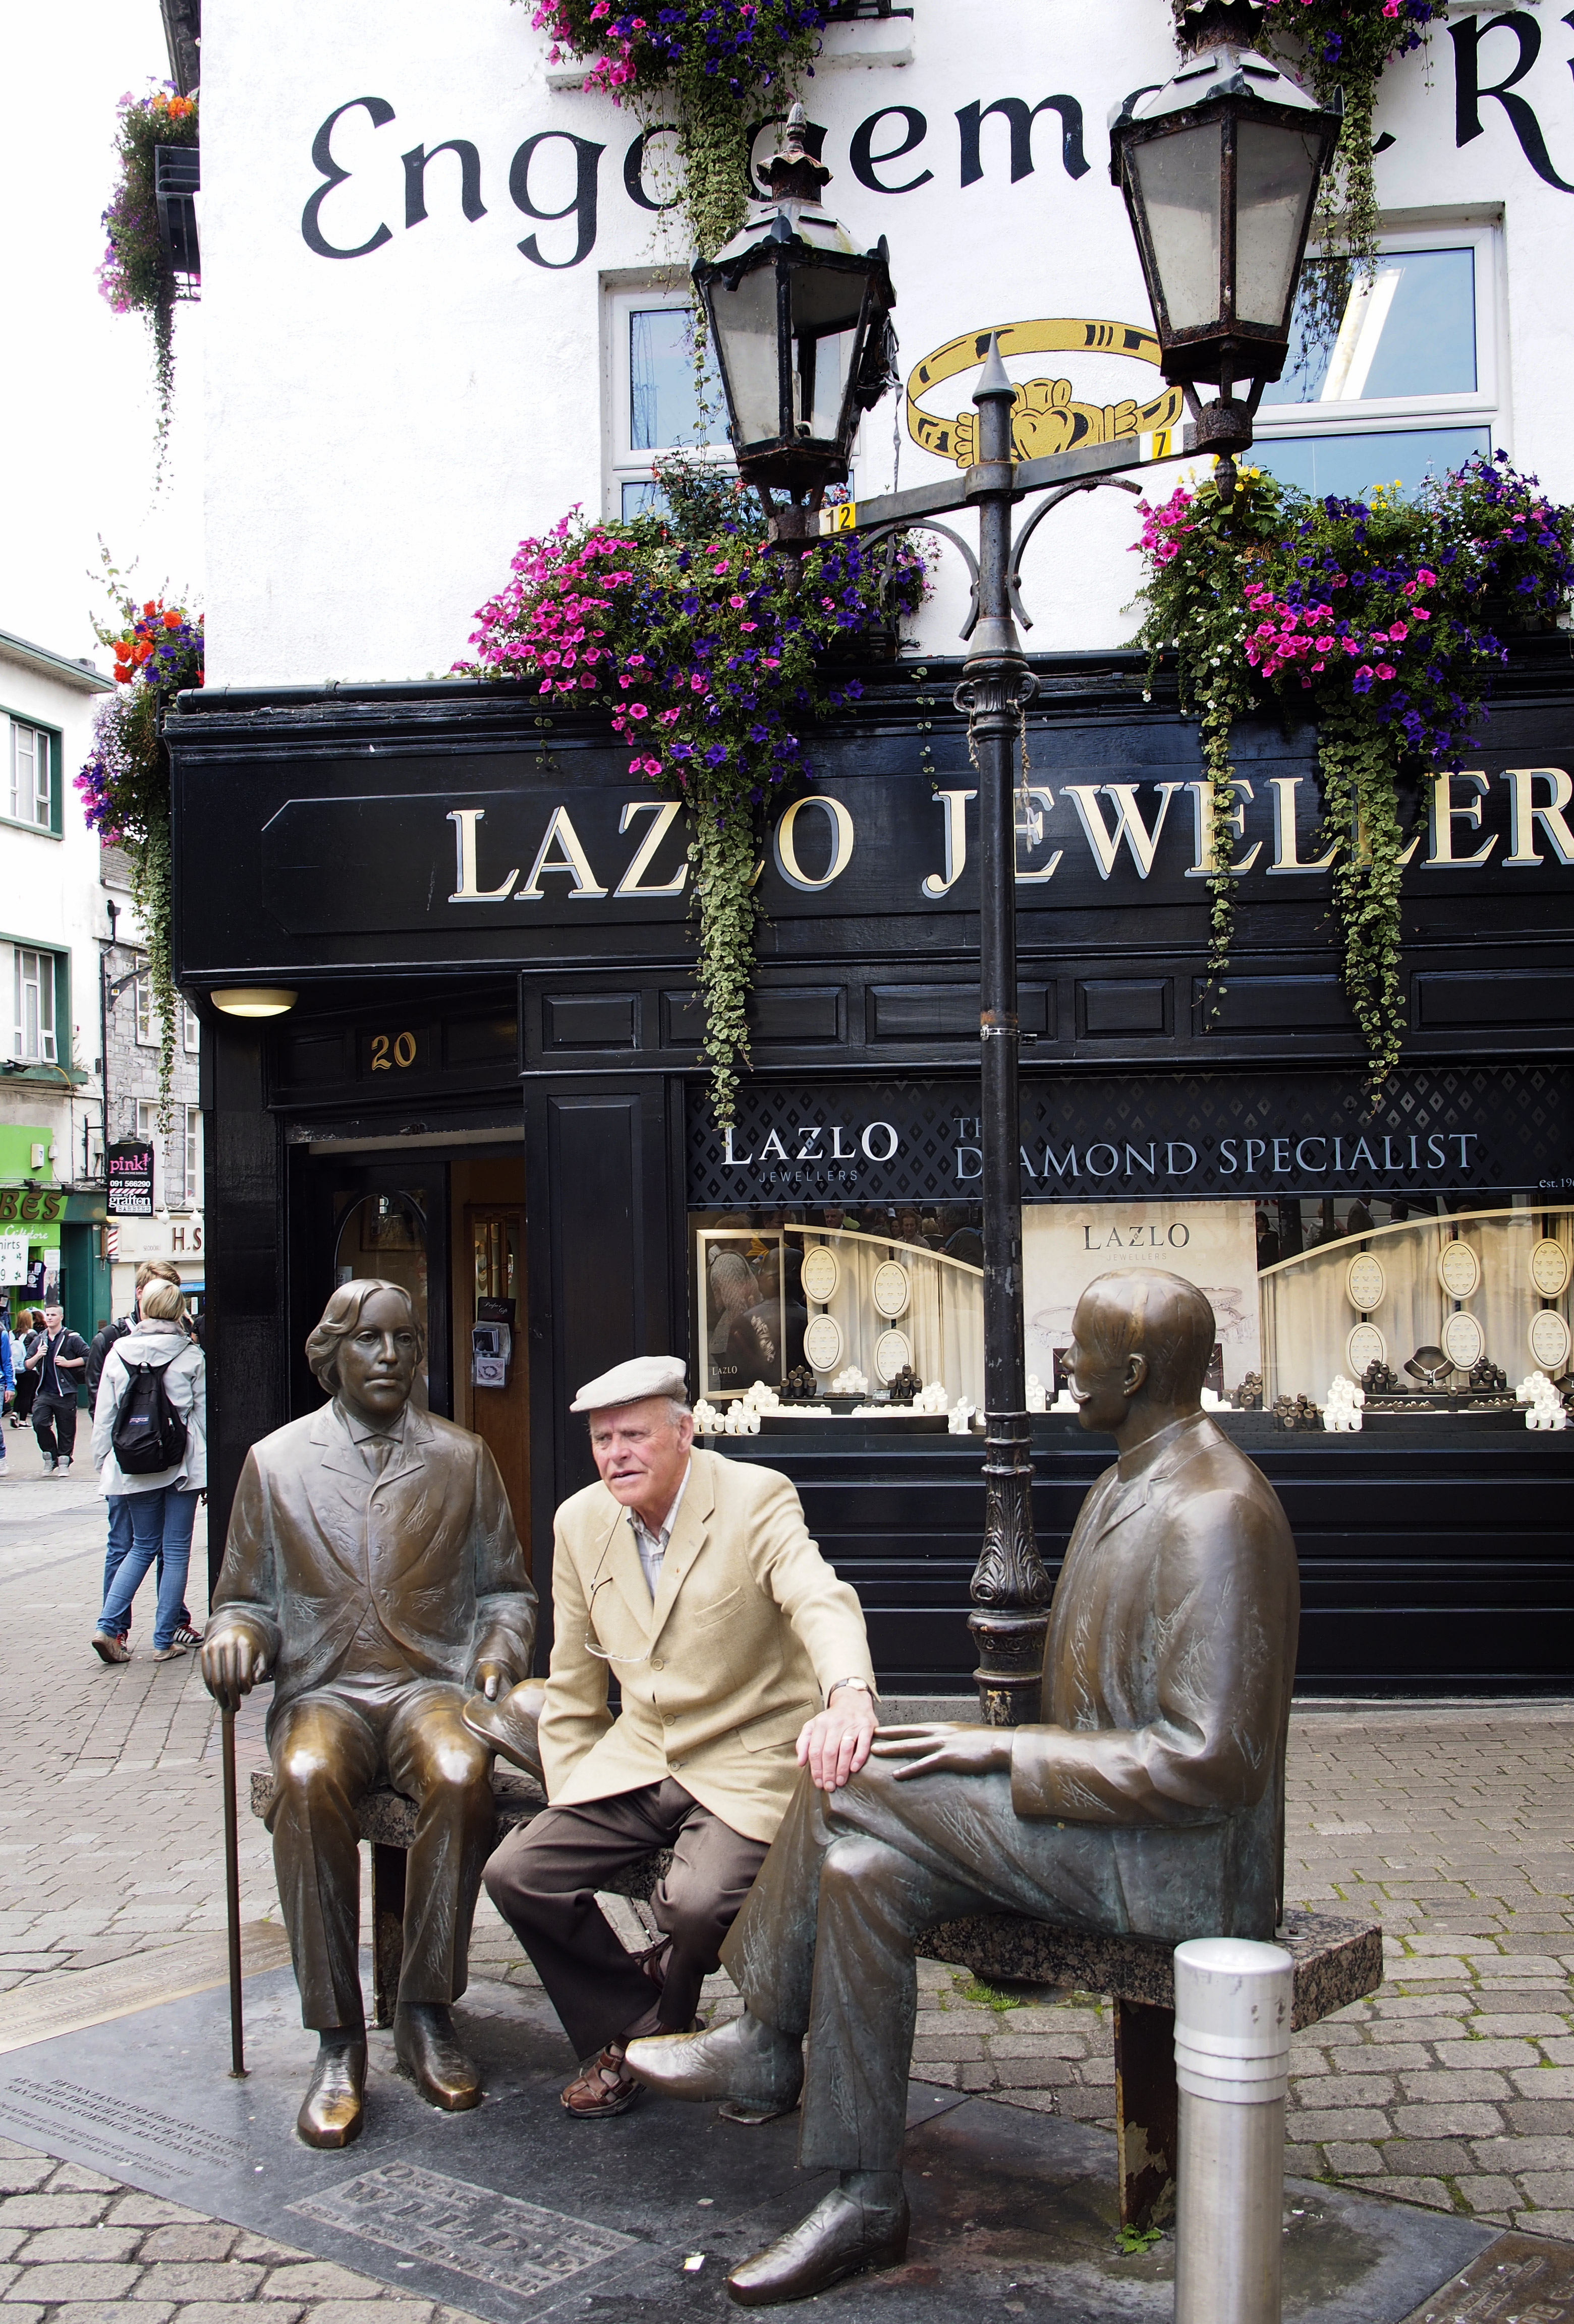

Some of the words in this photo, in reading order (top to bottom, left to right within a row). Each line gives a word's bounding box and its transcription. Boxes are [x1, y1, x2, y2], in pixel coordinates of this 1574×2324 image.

[302, 85, 1396, 269] Engaem
[1446, 10, 1574, 195] R
[1154, 431, 1166, 457] 7
[825, 506, 851, 533] 12
[446, 795, 854, 903] LAZO
[371, 1032, 416, 1070] 20
[953, 1117, 982, 1138] TH
[721, 1121, 898, 1166] LAZLO
[954, 1141, 1198, 1179] DAMOND
[1219, 1133, 1478, 1174] SPECIALIST
[109, 1153, 149, 1174] pink!
[759, 1170, 858, 1183] JEWELLERS
[1539, 1179, 1558, 1188] est.
[108, 1193, 151, 1208] grafton
[1082, 1223, 1190, 1251] LAZLO
[1107, 1253, 1167, 1261] JEWELLERS
[712, 1365, 738, 1375] LAZLO
[50, 2079, 130, 2107] BRONNTANAS
[127, 2105, 147, 2114] DO
[4, 2085, 32, 2095] SAN
[27, 2094, 77, 2111] AONTAS
[132, 2130, 206, 2158] BEALTAINE
[65, 2095, 123, 2116] THEACHT
[119, 2114, 177, 2135] ISTEACH
[32, 2125, 60, 2137] IRISH
[57, 2134, 79, 2144] PUB
[82, 2143, 115, 2156] TARTU
[341, 2180, 589, 2275] WILDE
